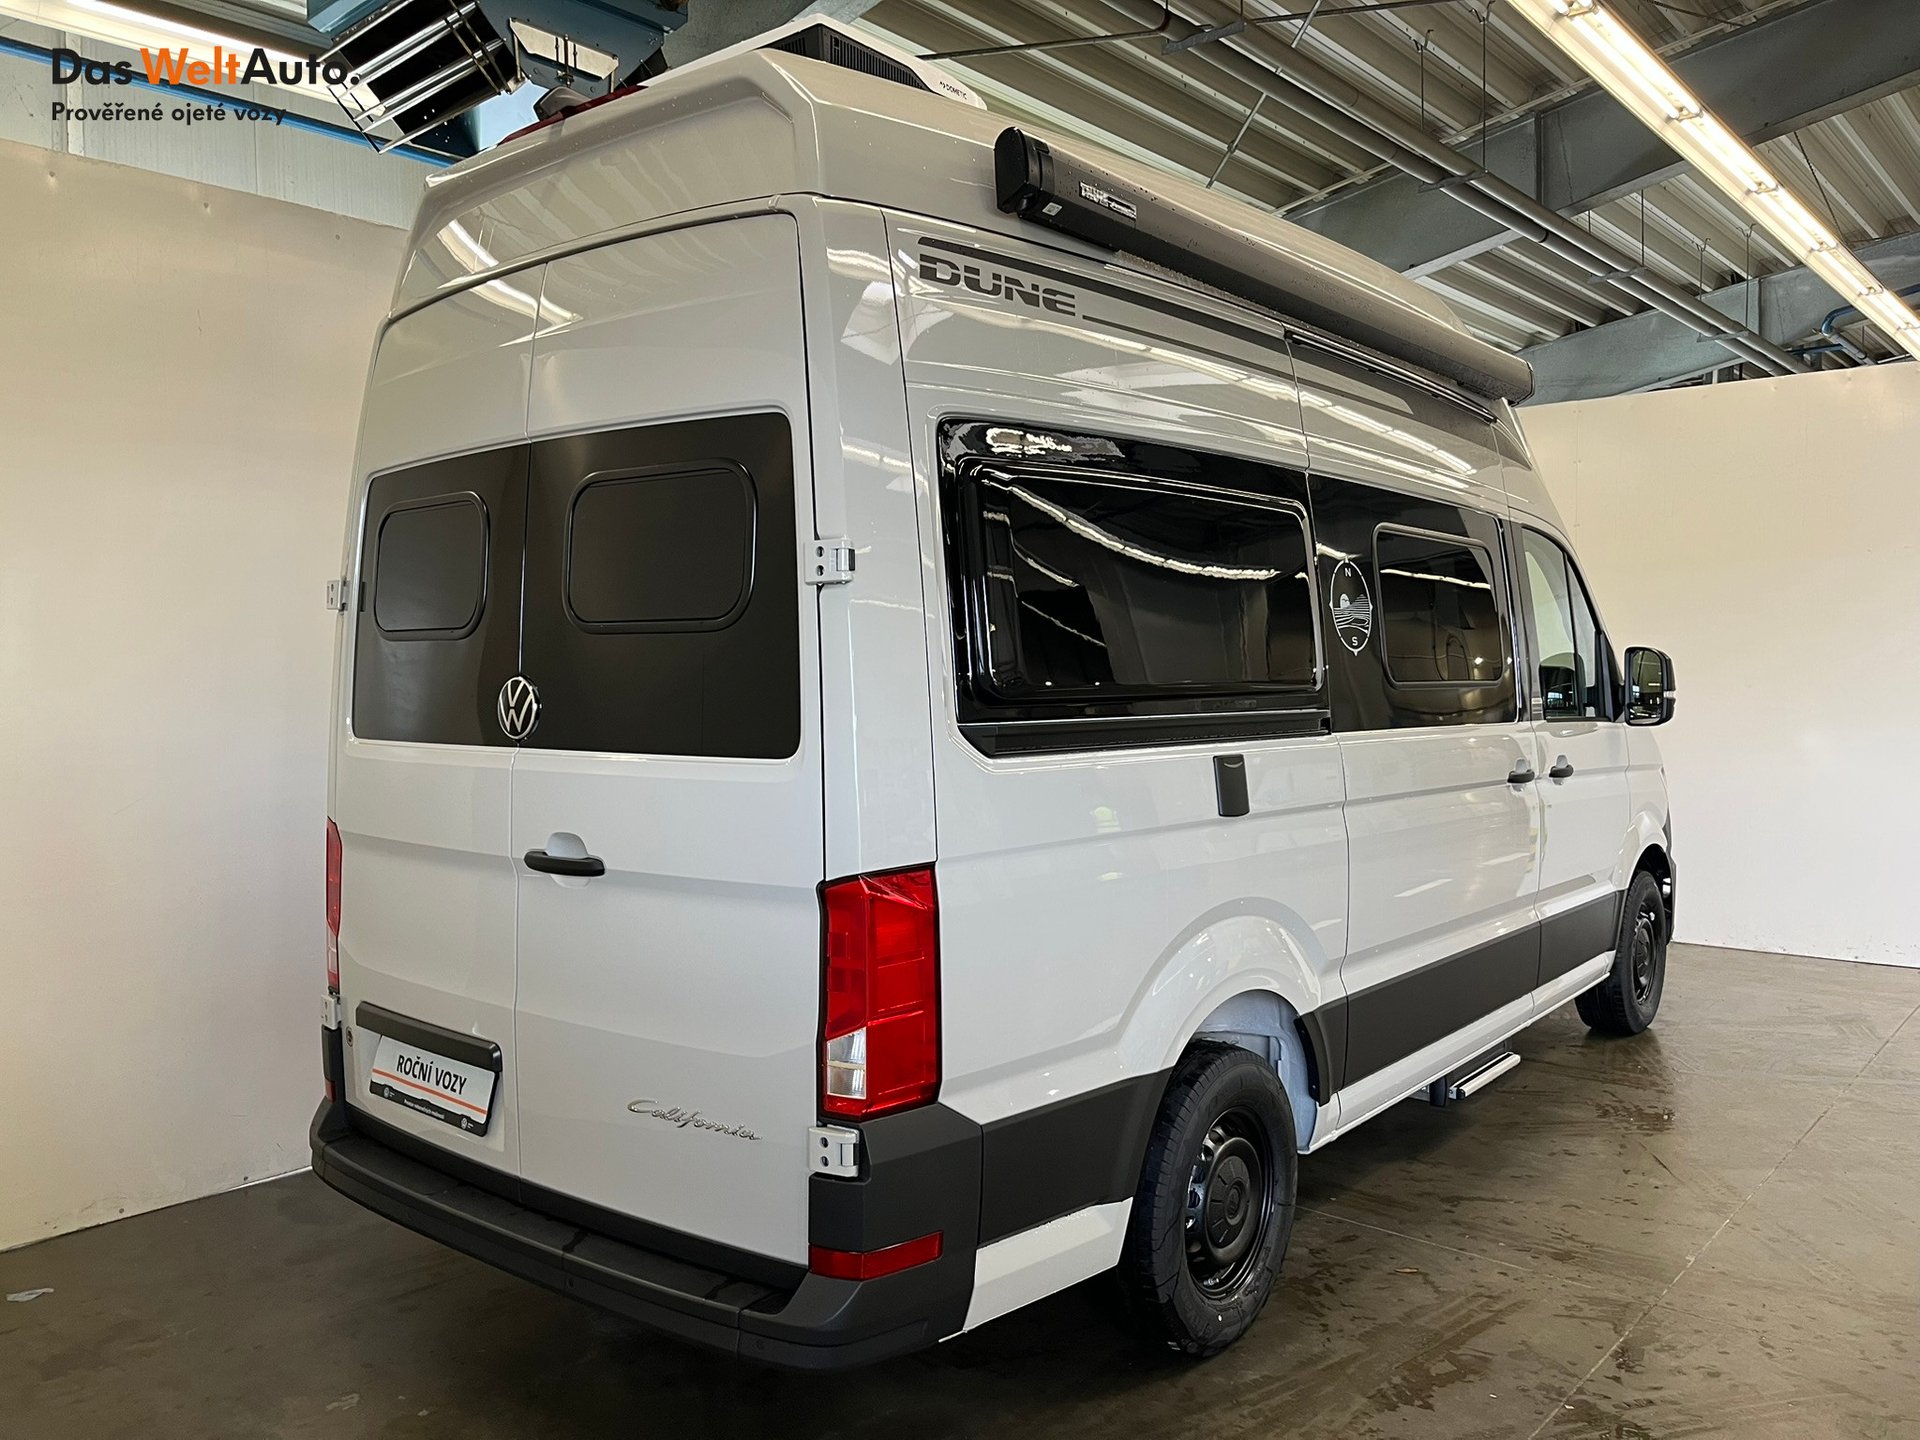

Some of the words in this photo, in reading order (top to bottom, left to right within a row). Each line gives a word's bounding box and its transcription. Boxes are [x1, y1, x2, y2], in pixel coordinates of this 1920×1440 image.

[919, 253, 1076, 317] DUNE
[1344, 567, 1352, 578] N
[1351, 636, 1359, 647] S
[396, 1054, 434, 1083] ROČNÍ
[435, 1067, 467, 1095] VOZY
[627, 1098, 763, 1140] California
